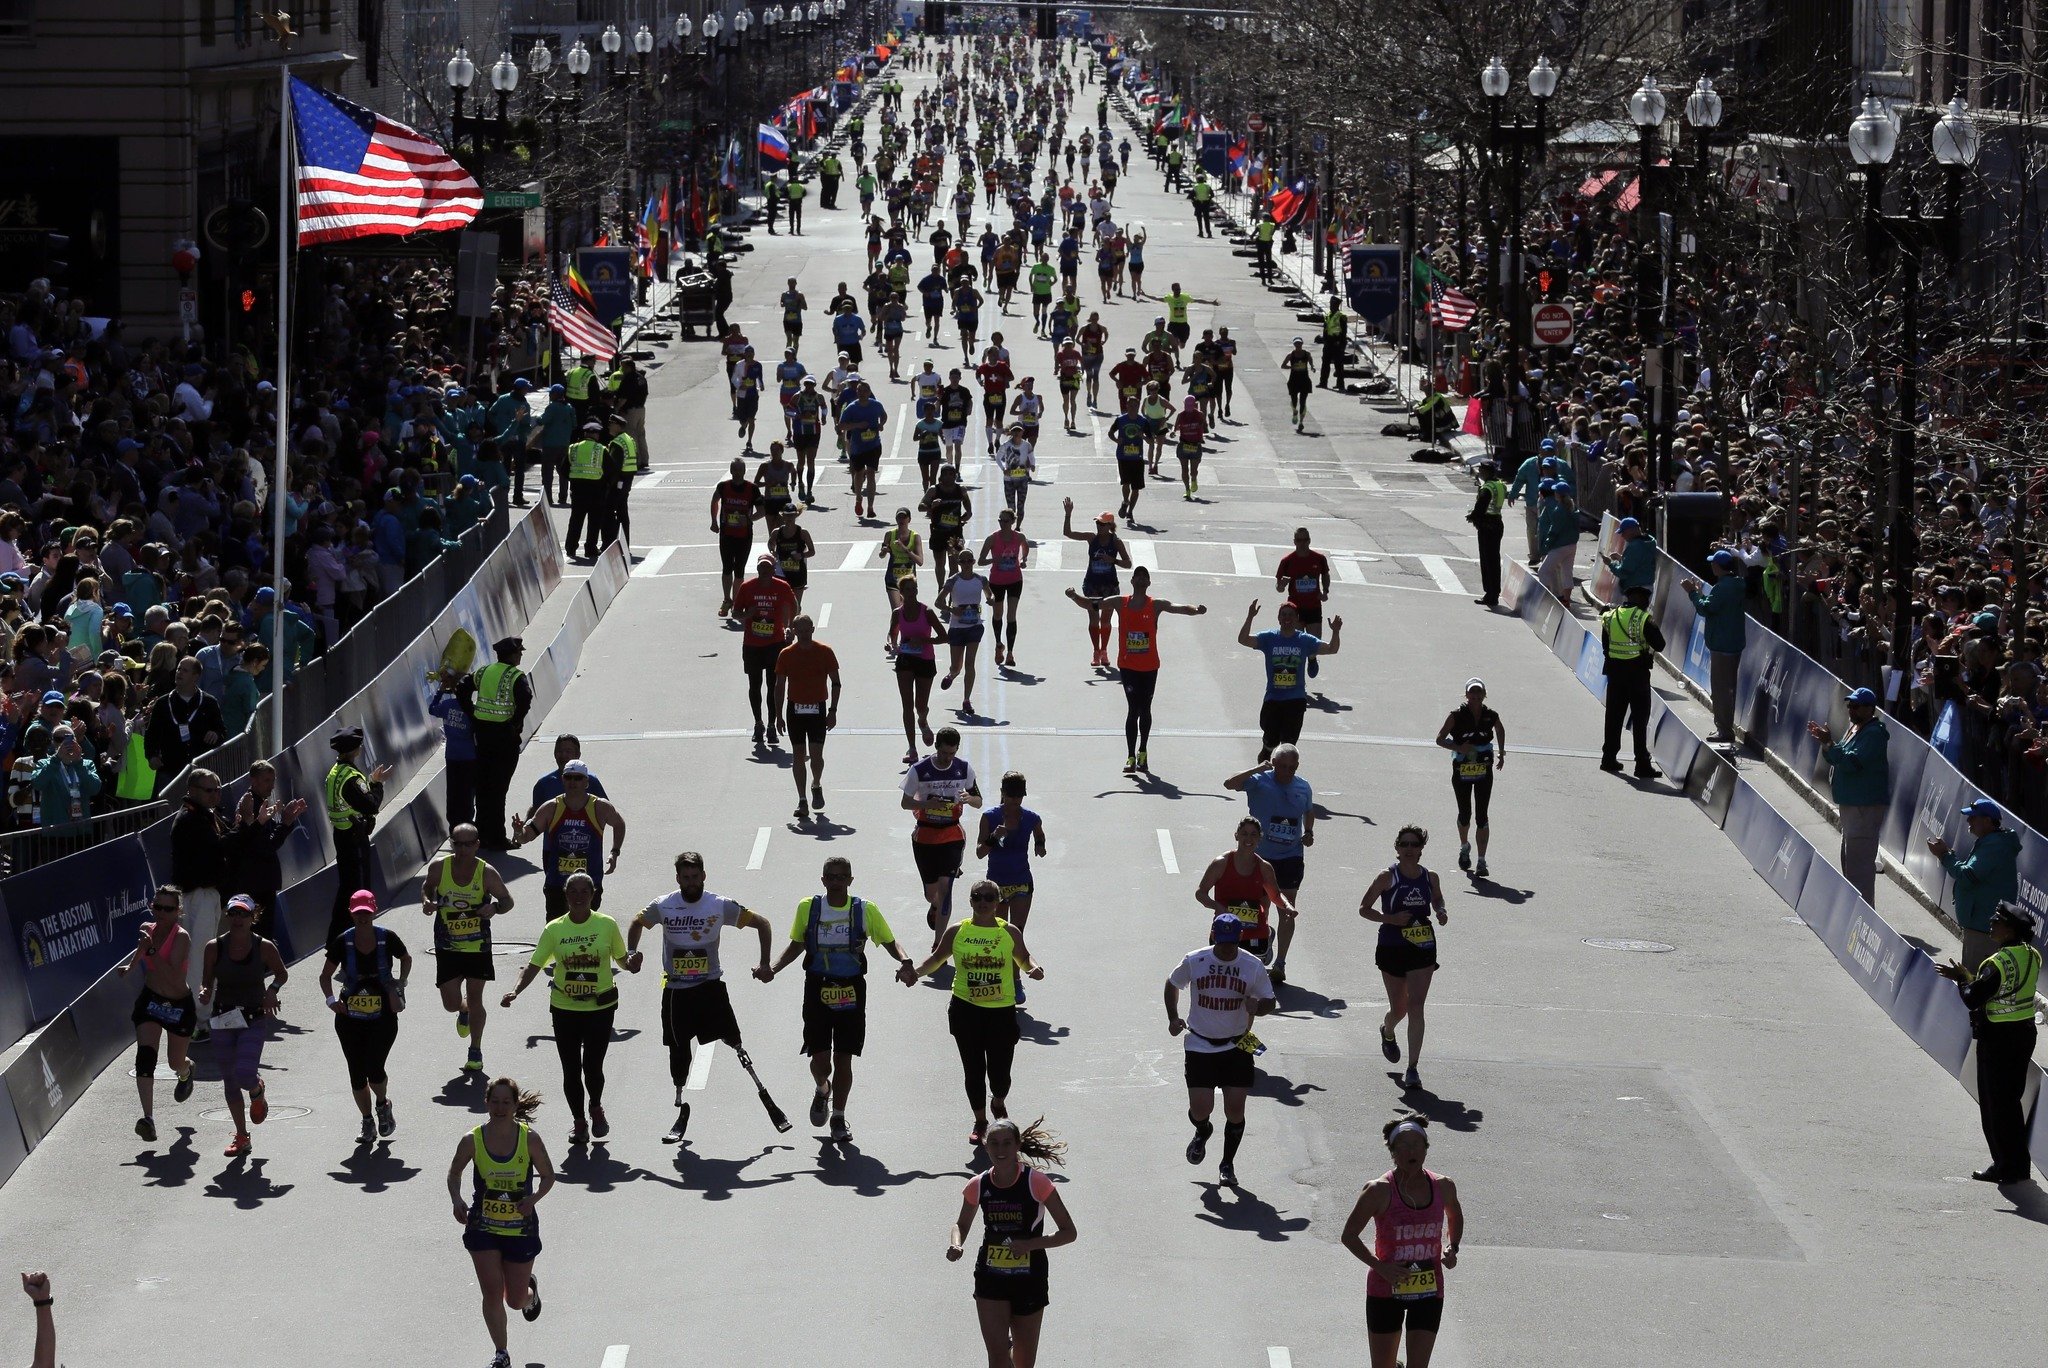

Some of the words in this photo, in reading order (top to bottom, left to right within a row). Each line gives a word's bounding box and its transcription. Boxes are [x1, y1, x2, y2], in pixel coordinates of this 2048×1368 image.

[494, 195, 526, 207] EXETER
[1543, 329, 1563, 337] ENTER
[752, 622, 775, 631] 26226
[564, 819, 587, 827] MIKE
[1269, 824, 1297, 836] 23336
[558, 858, 587, 869] 27628
[2020, 879, 2031, 900] THE
[40, 914, 60, 937] THE
[59, 901, 94, 930] BOSTON
[448, 918, 480, 931] 26962
[663, 915, 706, 927] Achilles
[47, 924, 100, 963] MARATHON
[560, 936, 589, 946] Achilles
[964, 937, 994, 946] Achilles
[1866, 927, 1883, 954] BOSTON
[674, 958, 708, 970] 32057
[1208, 964, 1241, 977] SEAN
[967, 972, 1002, 982] GUIDE
[1196, 974, 1228, 990] BOSTON
[564, 984, 598, 996] GUIDE
[821, 988, 856, 1001] GUIDE
[970, 985, 1003, 998] 32031
[348, 997, 381, 1008] 24514
[1198, 994, 1244, 1011] DEPARTMENT
[493, 1179, 515, 1190] SUE
[987, 1203, 1024, 1211] STEPPING
[988, 1211, 1024, 1222] STRONG
[989, 1247, 1029, 1261] 2721
